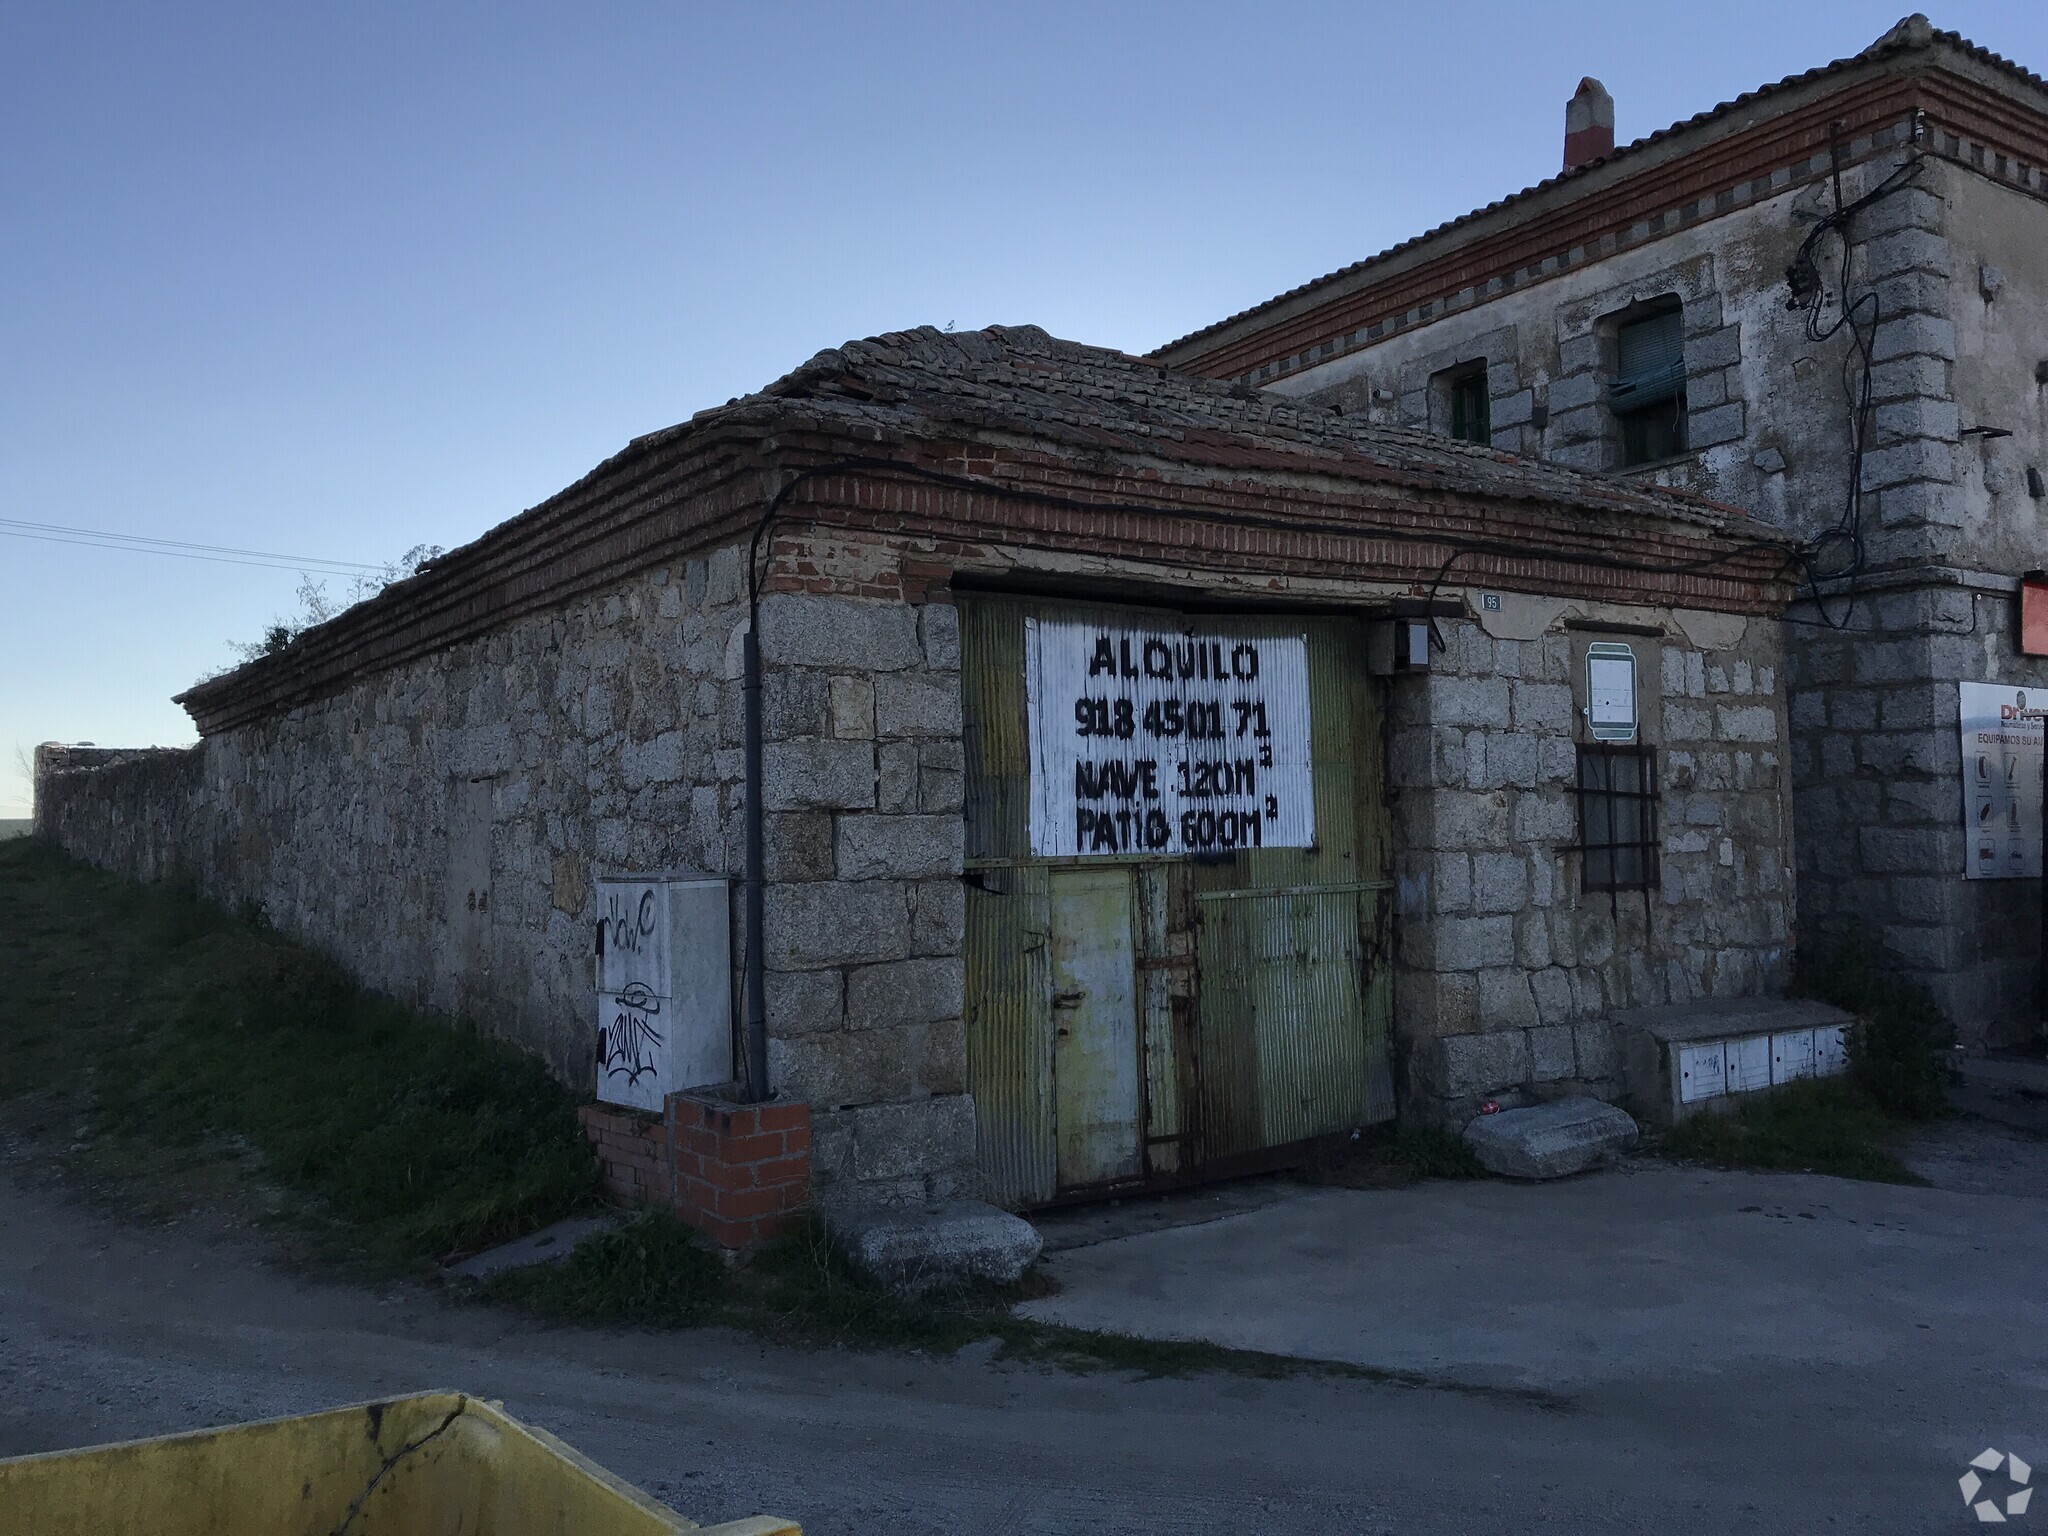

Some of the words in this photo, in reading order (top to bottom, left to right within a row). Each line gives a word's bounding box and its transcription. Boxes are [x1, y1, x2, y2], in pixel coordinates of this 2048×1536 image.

[1487, 596, 1497, 609] 95
[1089, 637, 1259, 682] ALQUILO
[1075, 698, 1136, 739] 918
[1978, 733, 2021, 745] EQUIPAMOS
[2022, 736, 2032, 746] SU
[1076, 758, 1159, 800] NAVE
[1076, 805, 1172, 852] PATIO
